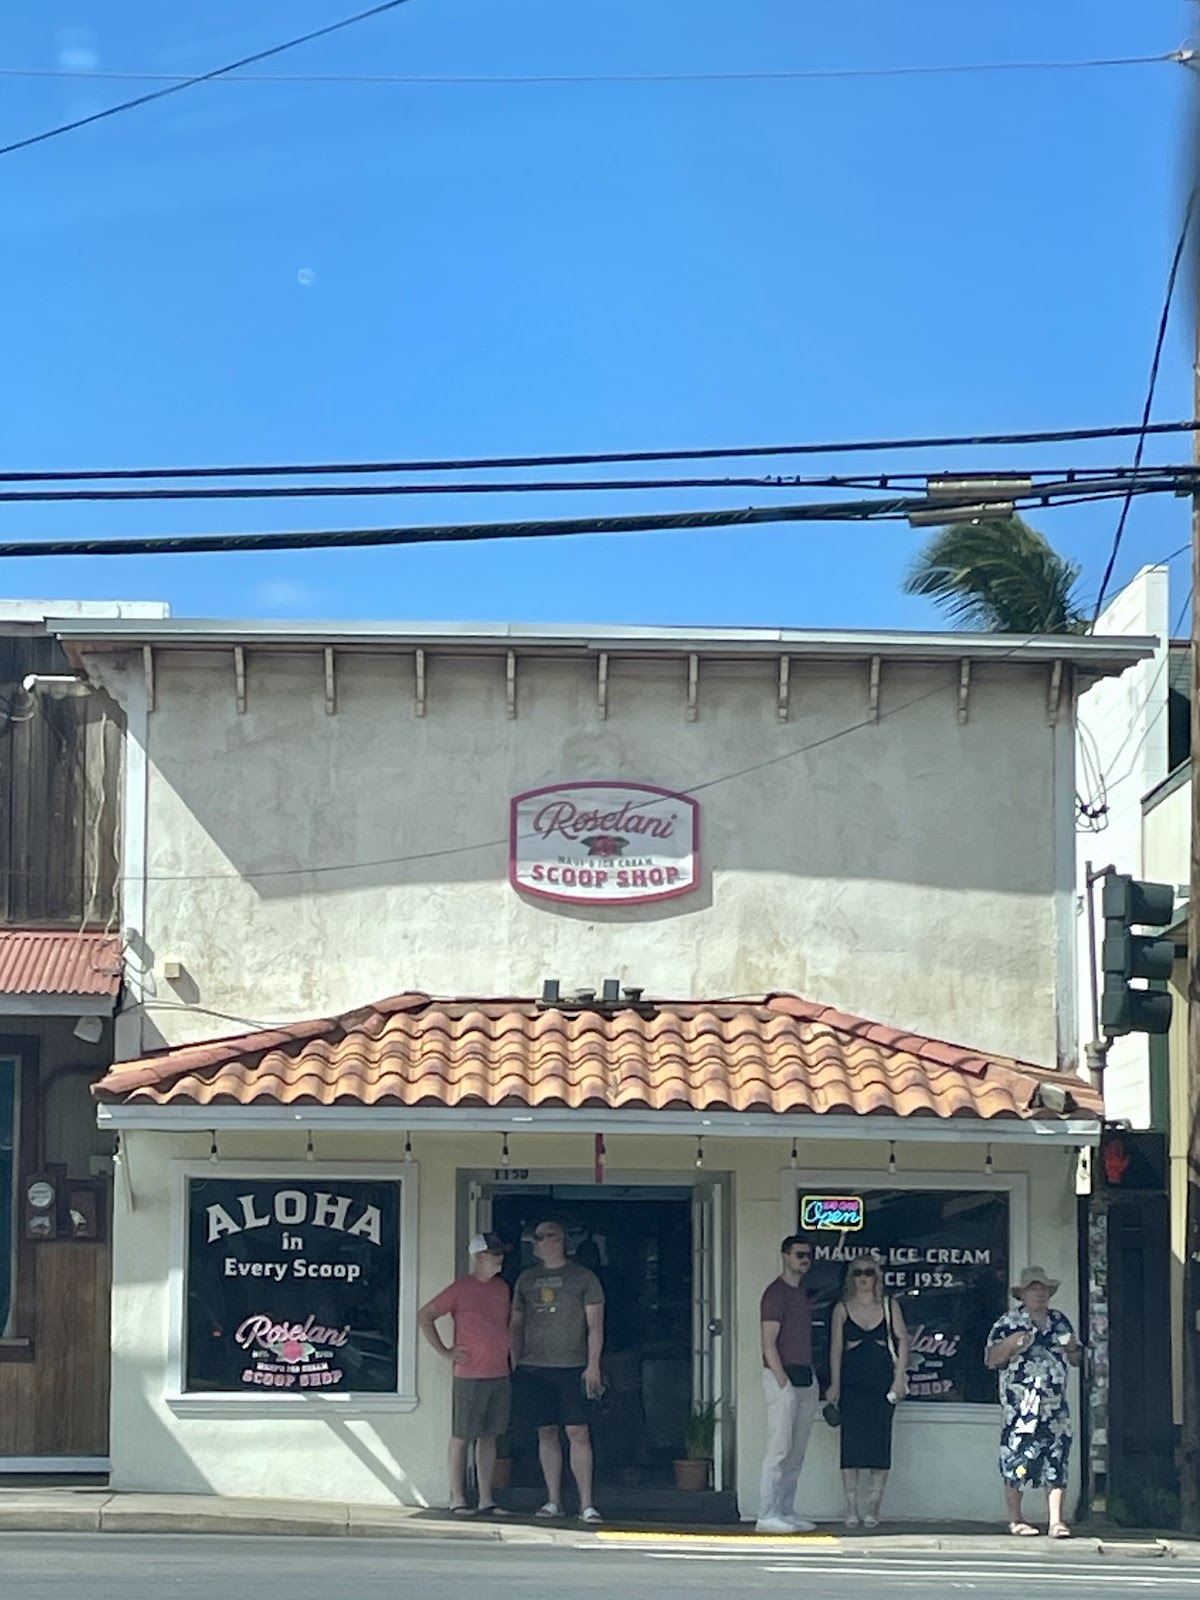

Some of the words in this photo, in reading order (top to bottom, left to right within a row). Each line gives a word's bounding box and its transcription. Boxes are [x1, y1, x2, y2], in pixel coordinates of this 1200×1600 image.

[533, 801, 678, 840] Roselani
[531, 864, 609, 888] SCOOP
[616, 866, 680, 888] SHOP
[205, 1189, 382, 1246] ALOHA
[805, 1200, 861, 1228] Open
[282, 1231, 304, 1251] in
[889, 1247, 919, 1262] ICE
[926, 1248, 991, 1265] CREAM
[224, 1257, 288, 1281] Every
[293, 1258, 361, 1282] Scoop
[914, 1271, 953, 1288] 1932
[235, 1314, 351, 1349] Roselani
[908, 1324, 961, 1357] lani
[242, 1369, 295, 1387] SCOOP
